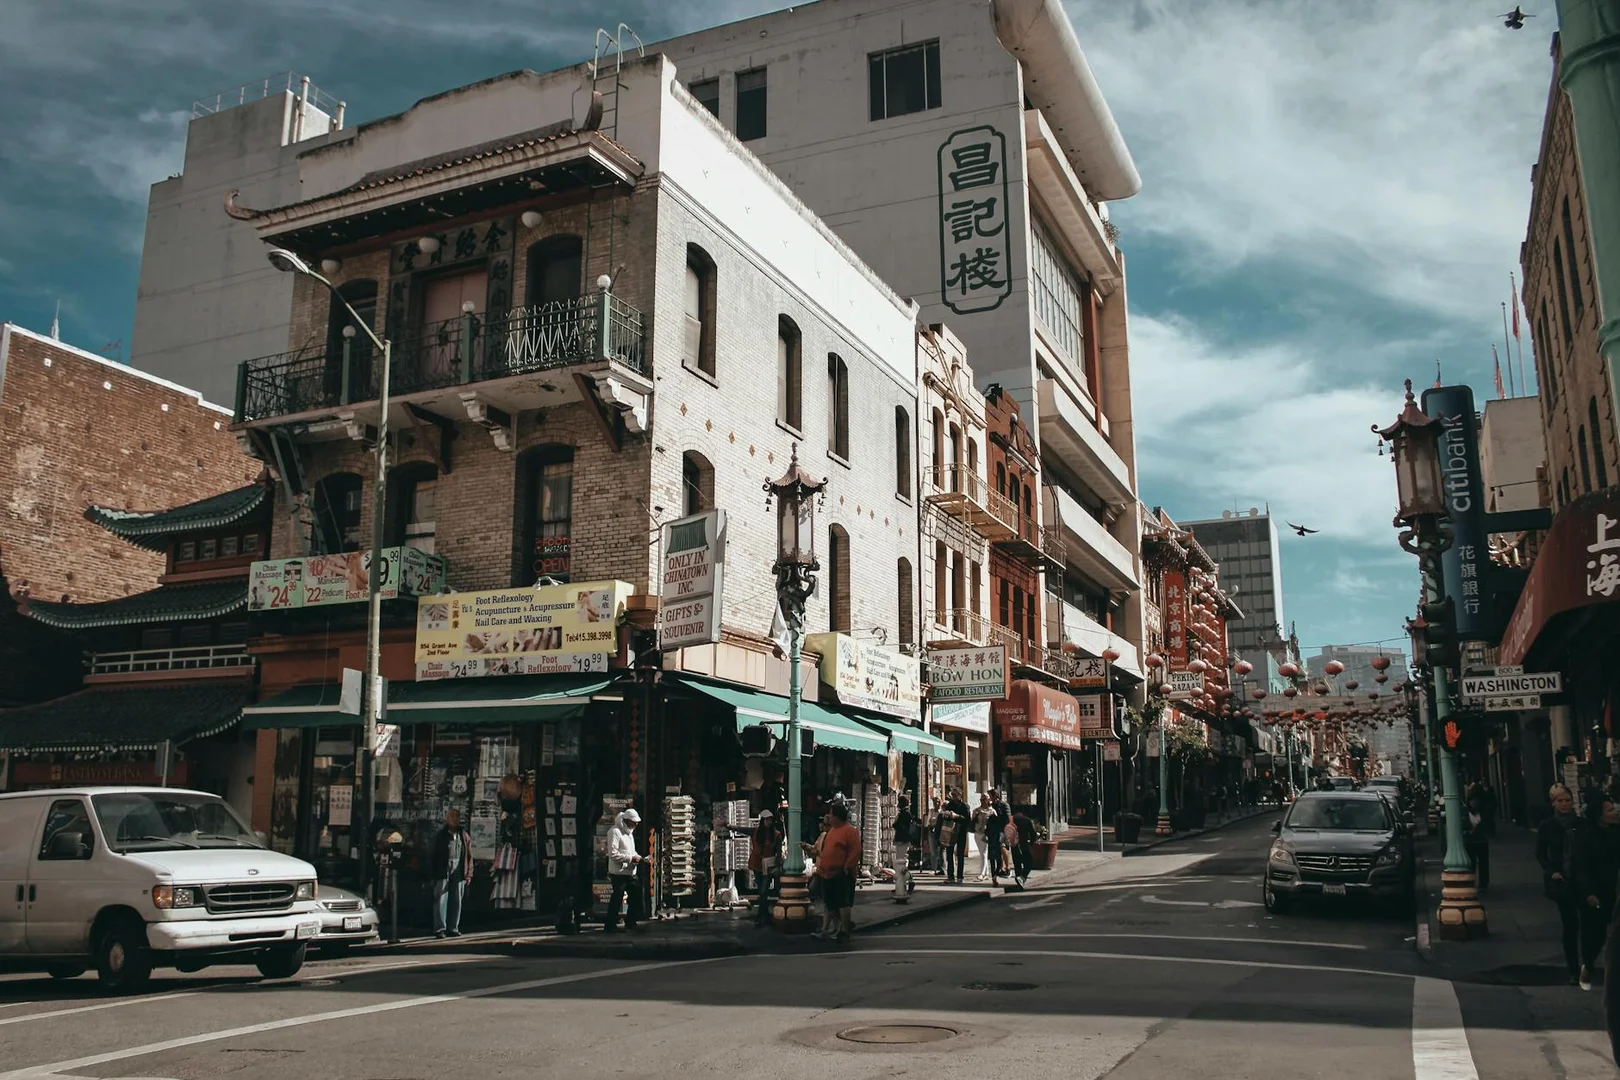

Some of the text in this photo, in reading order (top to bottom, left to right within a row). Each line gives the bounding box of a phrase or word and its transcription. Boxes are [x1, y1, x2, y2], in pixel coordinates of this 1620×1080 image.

[1444, 413, 1471, 512] citibank
[668, 550, 705, 570] ONLY IN
[1587, 513, 1620, 597] 上海
[262, 564, 277, 572] Chair
[533, 557, 569, 574] OPEN
[255, 571, 283, 580] Massage
[664, 563, 709, 584] CHINATOWN
[1458, 545, 1480, 614] 花旗銀行
[317, 576, 347, 585] Manicure
[677, 581, 694, 595] INC.
[345, 590, 360, 600] Foot
[475, 593, 534, 605] Foot Reflexology
[475, 606, 521, 617] Acupuncture
[529, 602, 575, 613] Acupressure
[666, 603, 703, 622] GIFTS &
[475, 614, 552, 627] Nail Care and Waxing
[664, 621, 704, 639] SOUVENIR
[427, 661, 443, 670] Chair
[541, 655, 557, 664] Foot
[422, 670, 449, 678] Massage
[527, 664, 572, 673] Reflexology
[932, 668, 1003, 684] BOW HON
[964, 684, 1004, 696] RESTAURANT
[1465, 676, 1557, 694] WASHINGTON
[455, 784, 464, 792] 66
